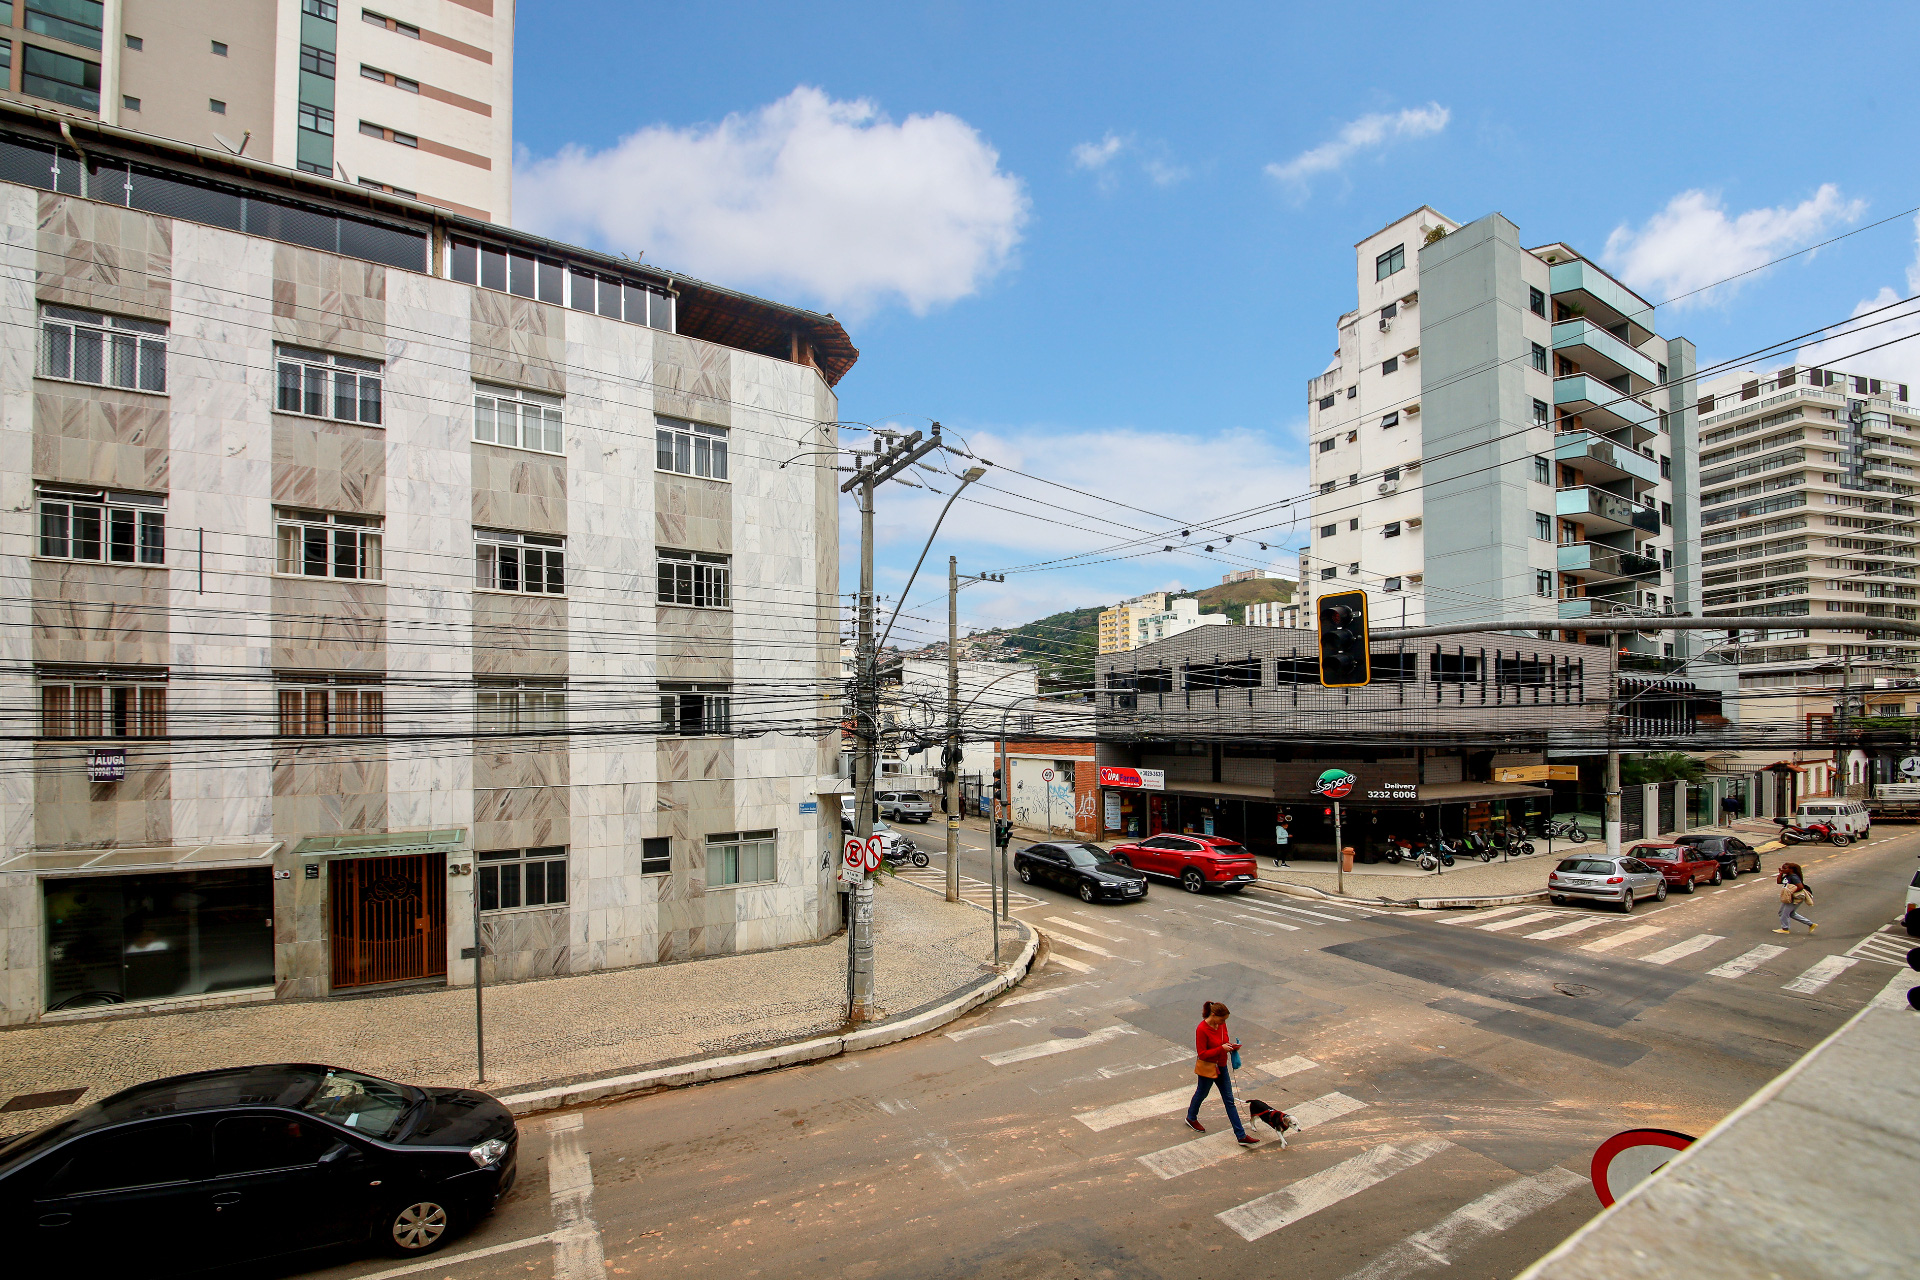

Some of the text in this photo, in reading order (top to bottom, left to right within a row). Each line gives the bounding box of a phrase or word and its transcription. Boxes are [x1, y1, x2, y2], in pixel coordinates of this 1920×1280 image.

[95, 754, 125, 765] ALUGA
[1107, 772, 1120, 781] UPA
[1120, 773, 1139, 783] Farma
[1310, 774, 1357, 794] Sapore
[1384, 782, 1417, 791] Delivery
[1367, 791, 1417, 799] 3232 6006
[449, 863, 471, 877] 35
